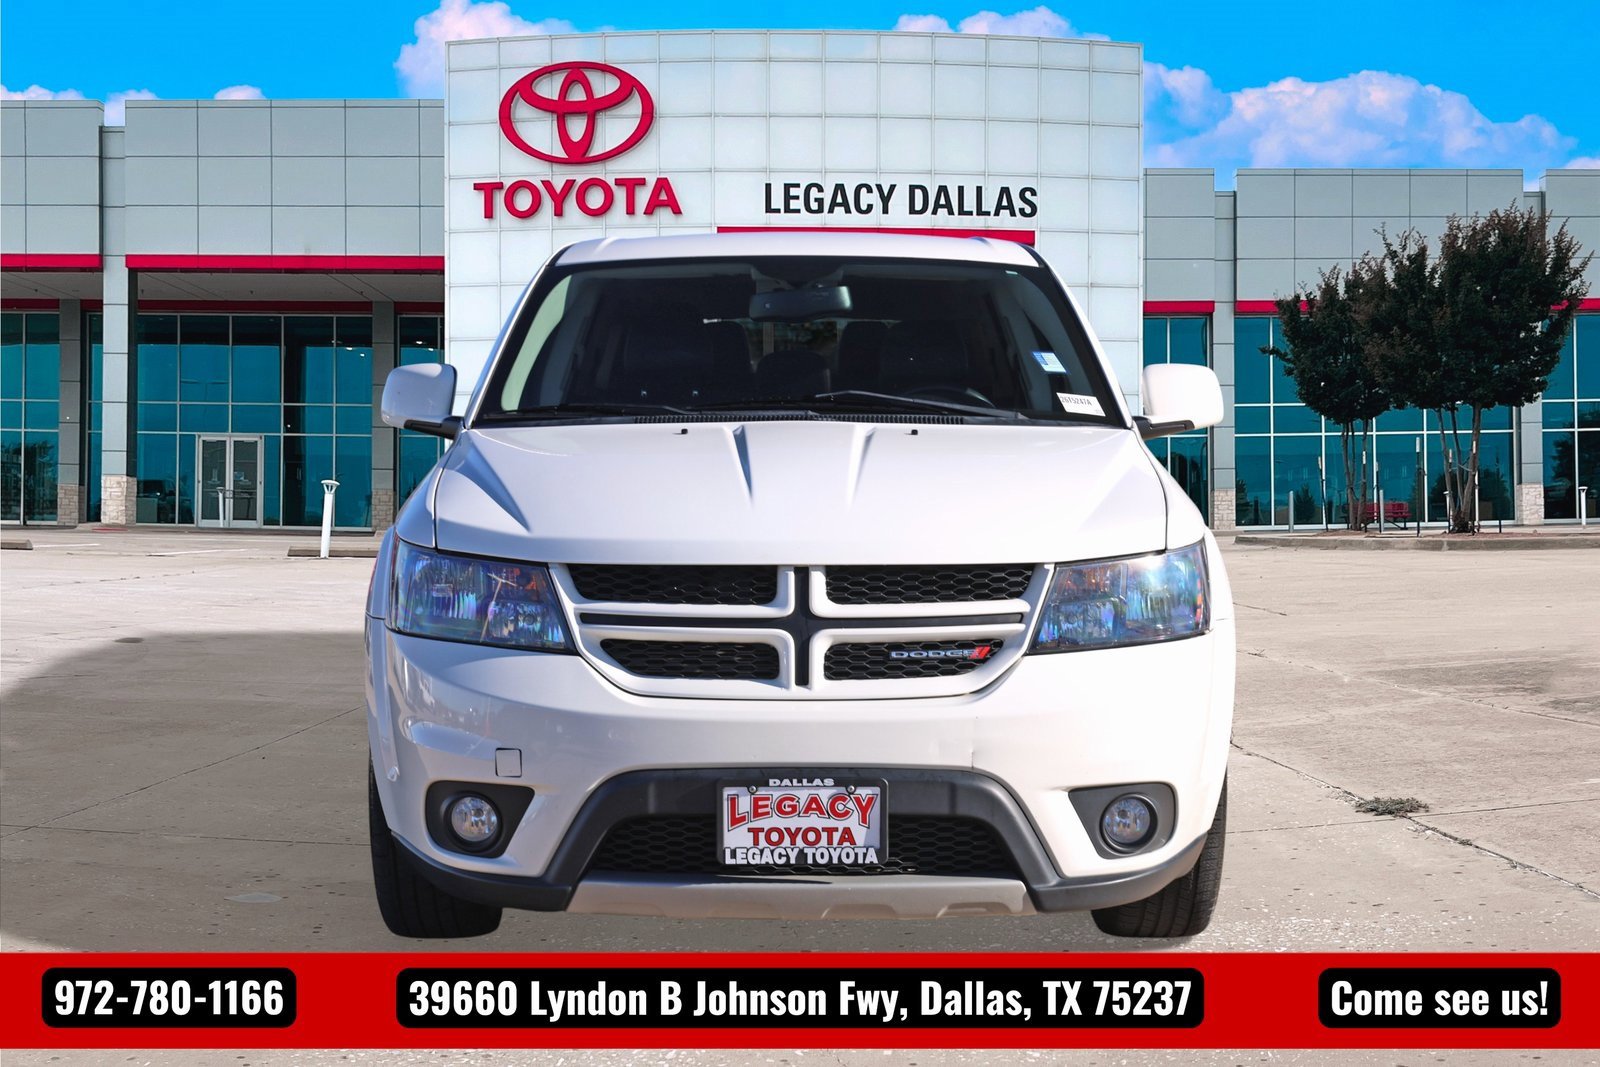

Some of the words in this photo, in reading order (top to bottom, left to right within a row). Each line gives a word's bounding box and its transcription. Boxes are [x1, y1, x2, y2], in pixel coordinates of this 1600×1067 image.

[473, 177, 682, 219] TOYOTA
[764, 182, 897, 215] LEGACY
[908, 184, 1038, 218] DALLAS
[890, 649, 978, 659] DODGE
[768, 778, 835, 787] DALLAS
[727, 793, 878, 832] LEGACY
[748, 827, 856, 846] TOYOTA
[724, 847, 800, 865] LEGACY
[803, 847, 879, 865] TOYOTA
